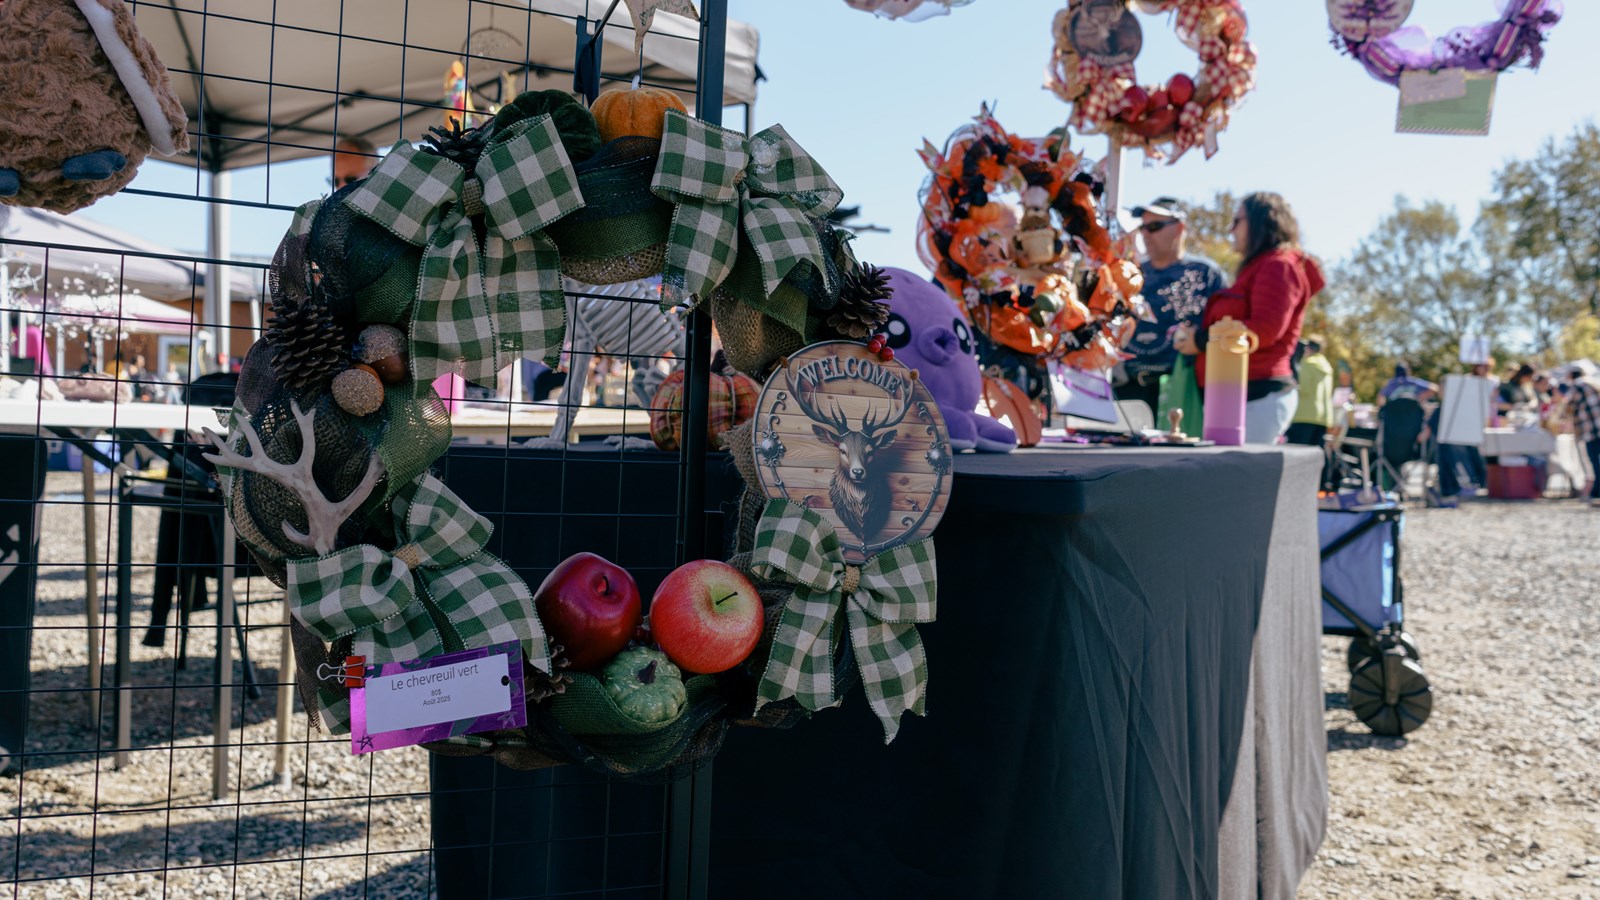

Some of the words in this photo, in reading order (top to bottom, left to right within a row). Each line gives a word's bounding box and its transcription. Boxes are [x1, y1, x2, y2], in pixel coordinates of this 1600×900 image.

[797, 355, 901, 393] WELCOME
[391, 679, 404, 691] Le
[406, 667, 455, 688] chevreuil
[457, 664, 479, 677] vert
[422, 698, 437, 706] Août
[436, 695, 451, 704] 2025
[431, 689, 442, 697] 80$
